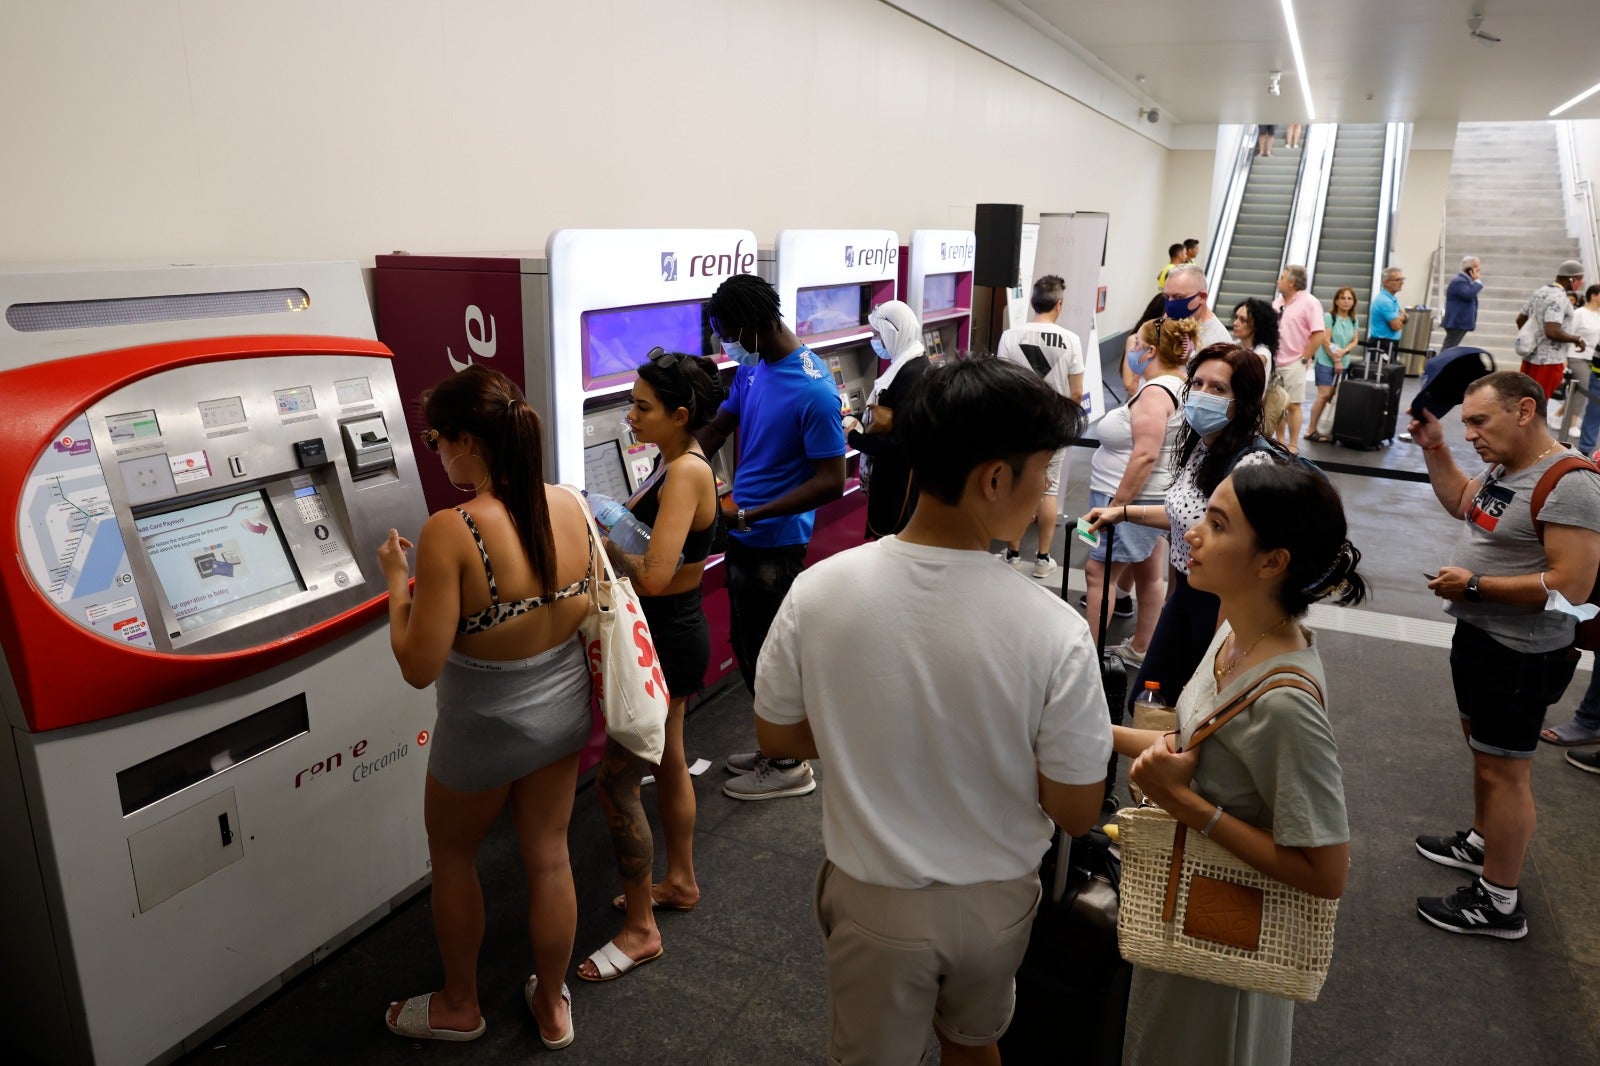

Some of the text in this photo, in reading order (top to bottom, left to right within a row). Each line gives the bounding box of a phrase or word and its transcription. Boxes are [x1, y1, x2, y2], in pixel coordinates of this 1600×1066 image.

[689, 239, 755, 278] renfe
[857, 237, 898, 274] renfe
[947, 236, 975, 267] renfe
